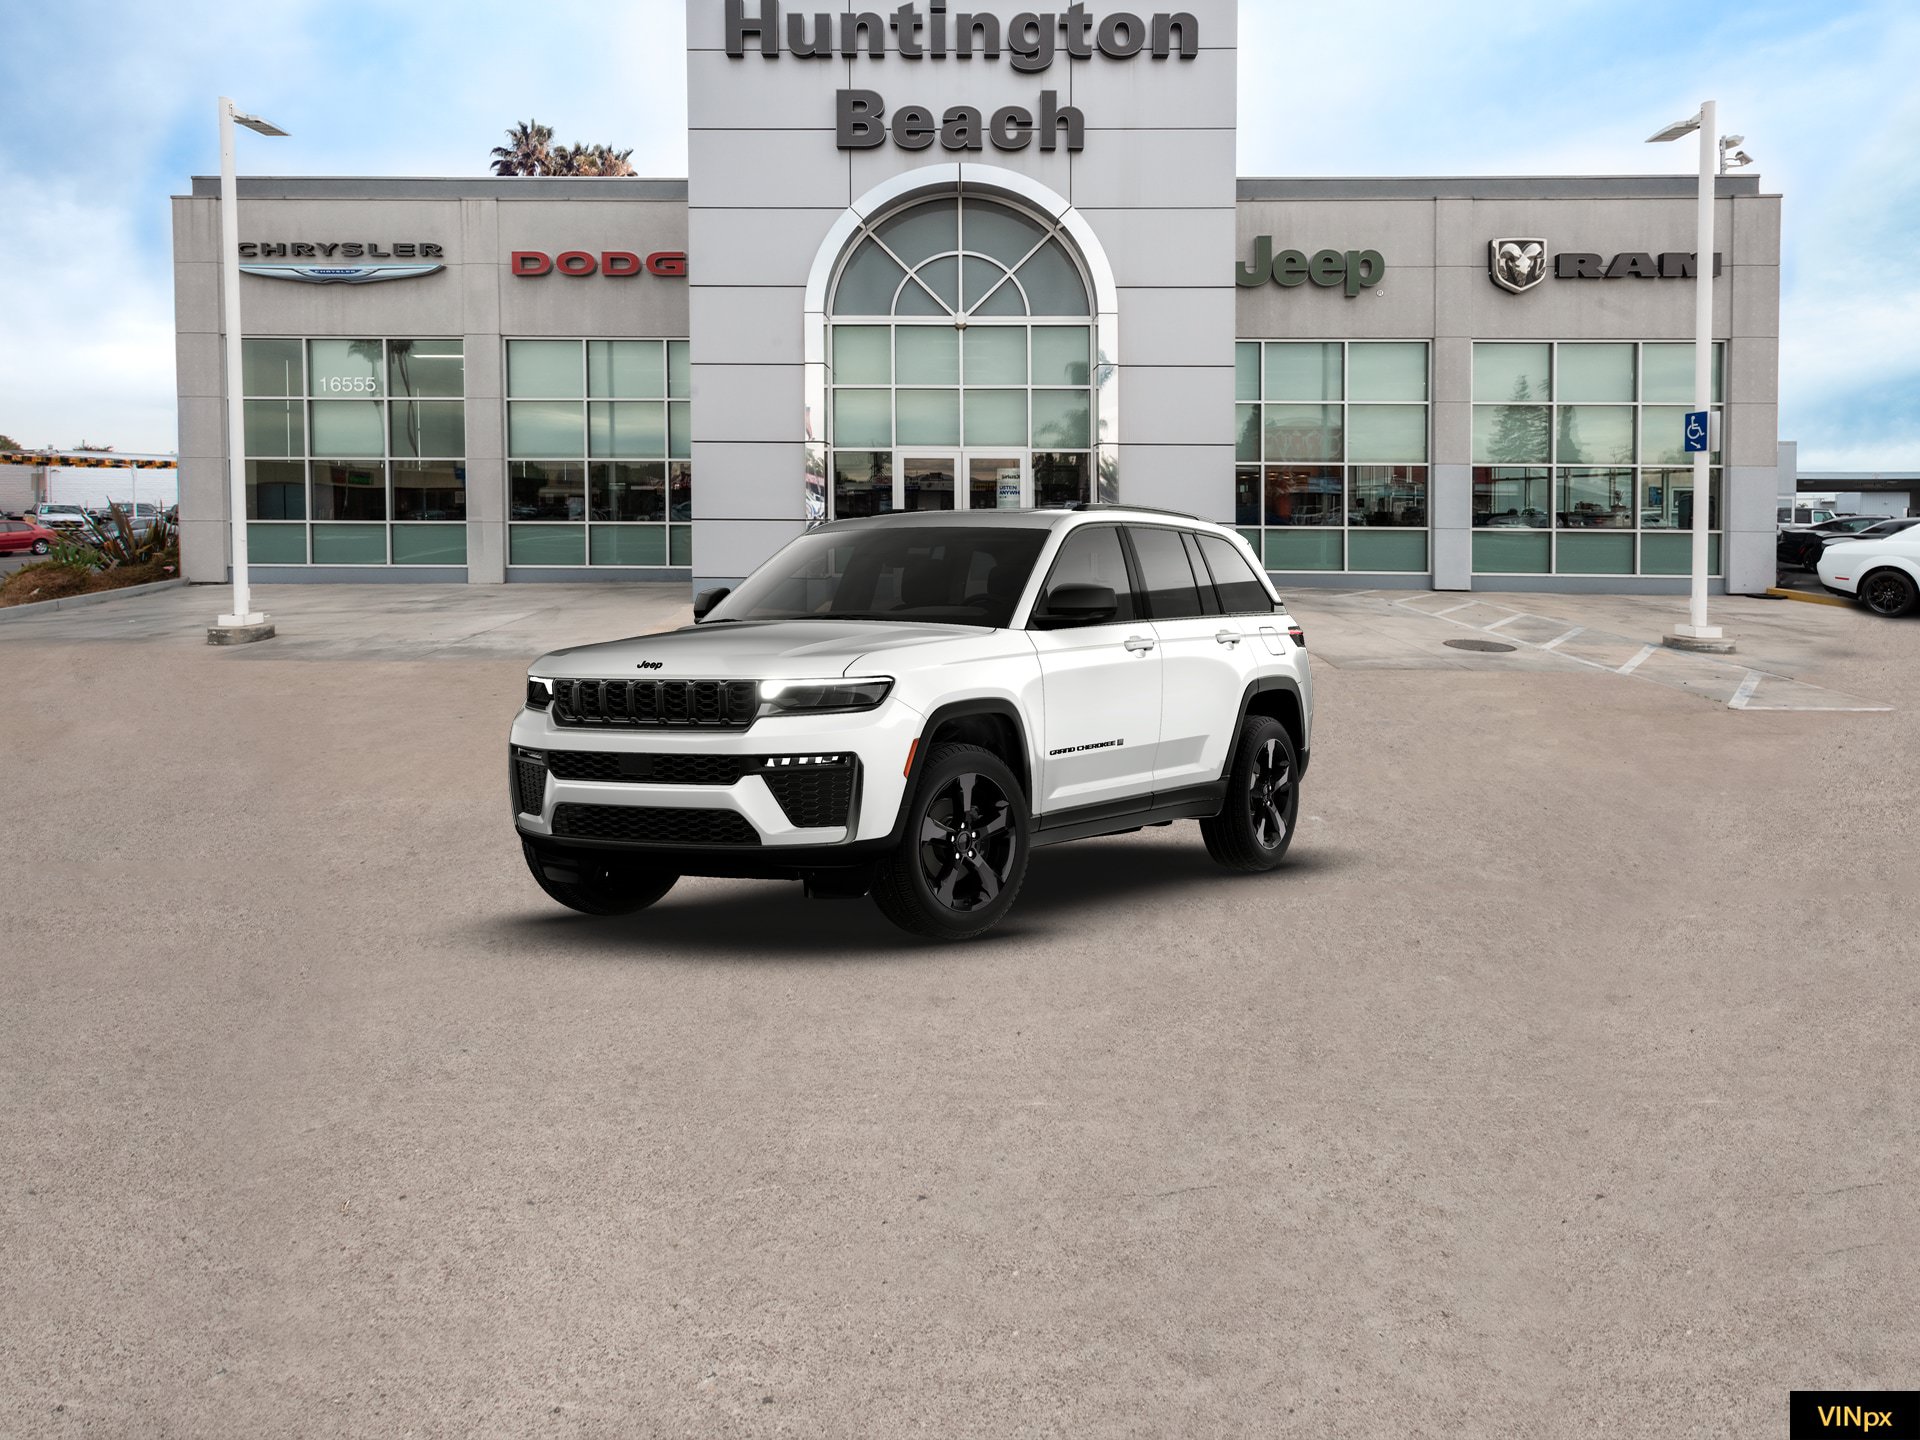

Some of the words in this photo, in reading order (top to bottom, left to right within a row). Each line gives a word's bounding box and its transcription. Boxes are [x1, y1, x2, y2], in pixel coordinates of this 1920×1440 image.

[725, 0, 1199, 73] Huntington
[836, 89, 1085, 152] Beach
[238, 242, 443, 258] CHRYSLER
[1236, 235, 1385, 298] Jeep
[1554, 252, 1722, 279] RAM
[320, 376, 376, 392] 16555
[636, 660, 663, 670] Jeep
[1049, 747, 1075, 755] GRAND
[1077, 741, 1115, 751] CHEROKEE
